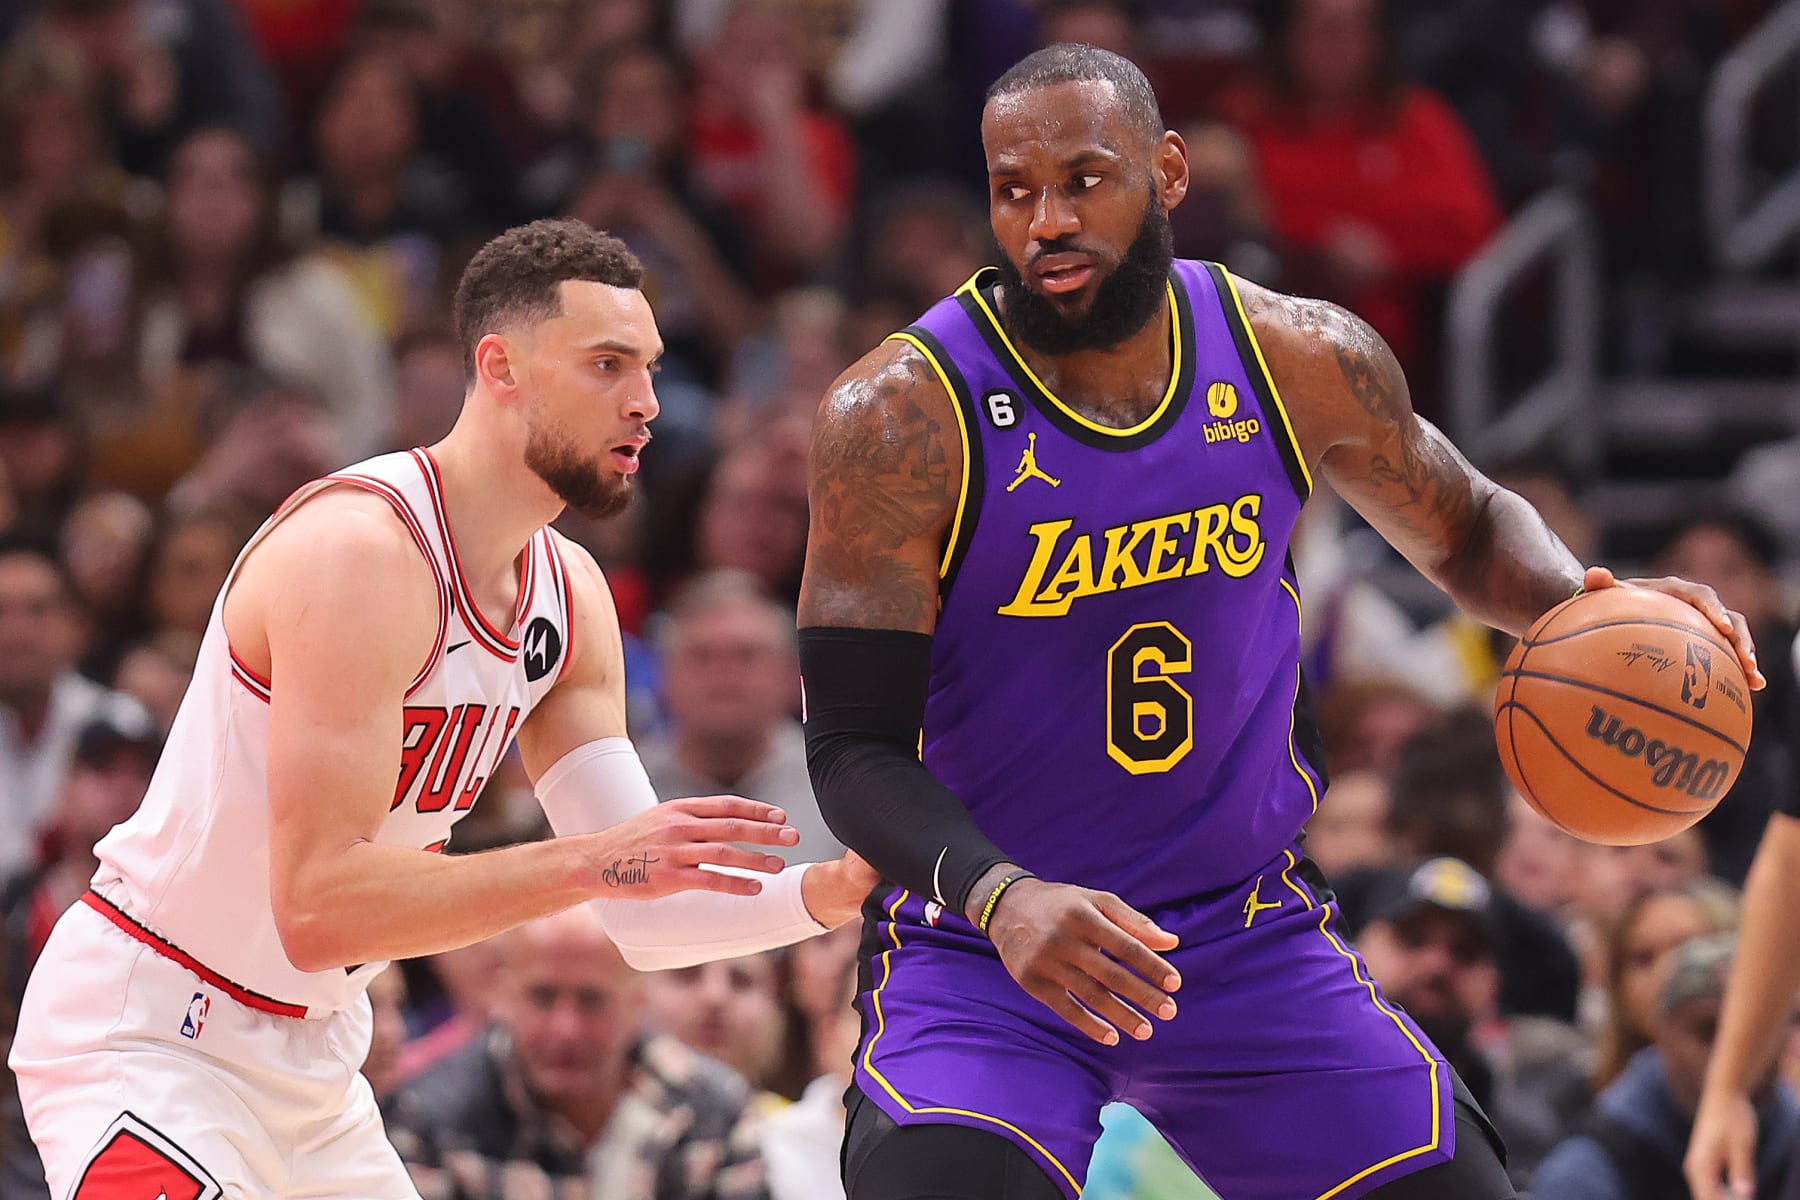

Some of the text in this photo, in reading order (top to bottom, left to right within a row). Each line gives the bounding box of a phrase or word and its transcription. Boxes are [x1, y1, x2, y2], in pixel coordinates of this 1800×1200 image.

[987, 392, 1016, 427] 6
[1203, 417, 1260, 444] bibigo
[997, 494, 1266, 618] LAKERS
[1106, 620, 1194, 776] 6
[1585, 704, 1731, 800] Wilson
[602, 851, 661, 888] Saint
[979, 881, 1007, 931] PROMISE
